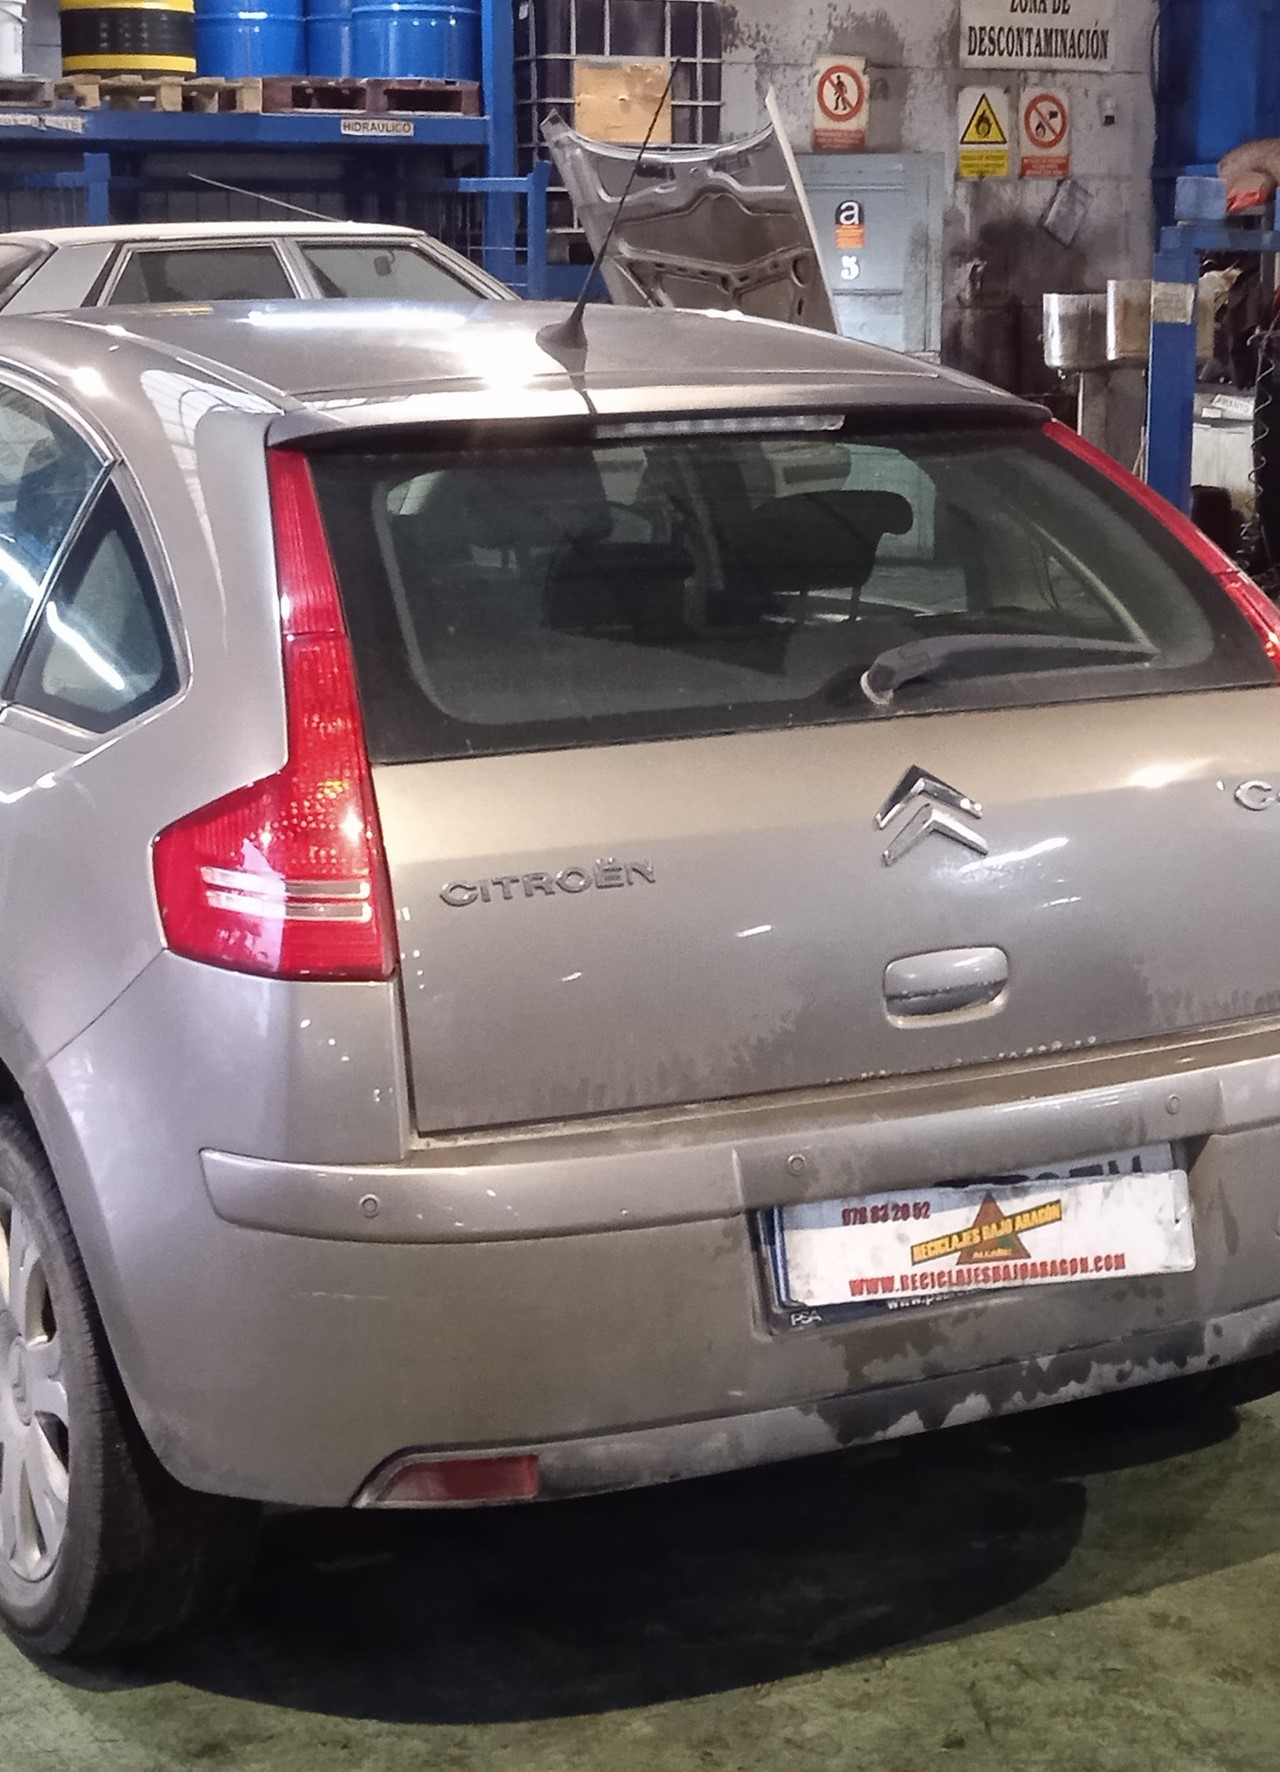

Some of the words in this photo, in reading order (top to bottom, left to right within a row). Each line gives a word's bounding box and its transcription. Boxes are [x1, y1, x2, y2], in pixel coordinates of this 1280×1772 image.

[968, 19, 1109, 60] DESCONTAMINACIÓN
[840, 201, 859, 225] a
[439, 857, 656, 907] CITROËN
[913, 1228, 981, 1261] RECICLAJES
[982, 1218, 1013, 1242] BAJO
